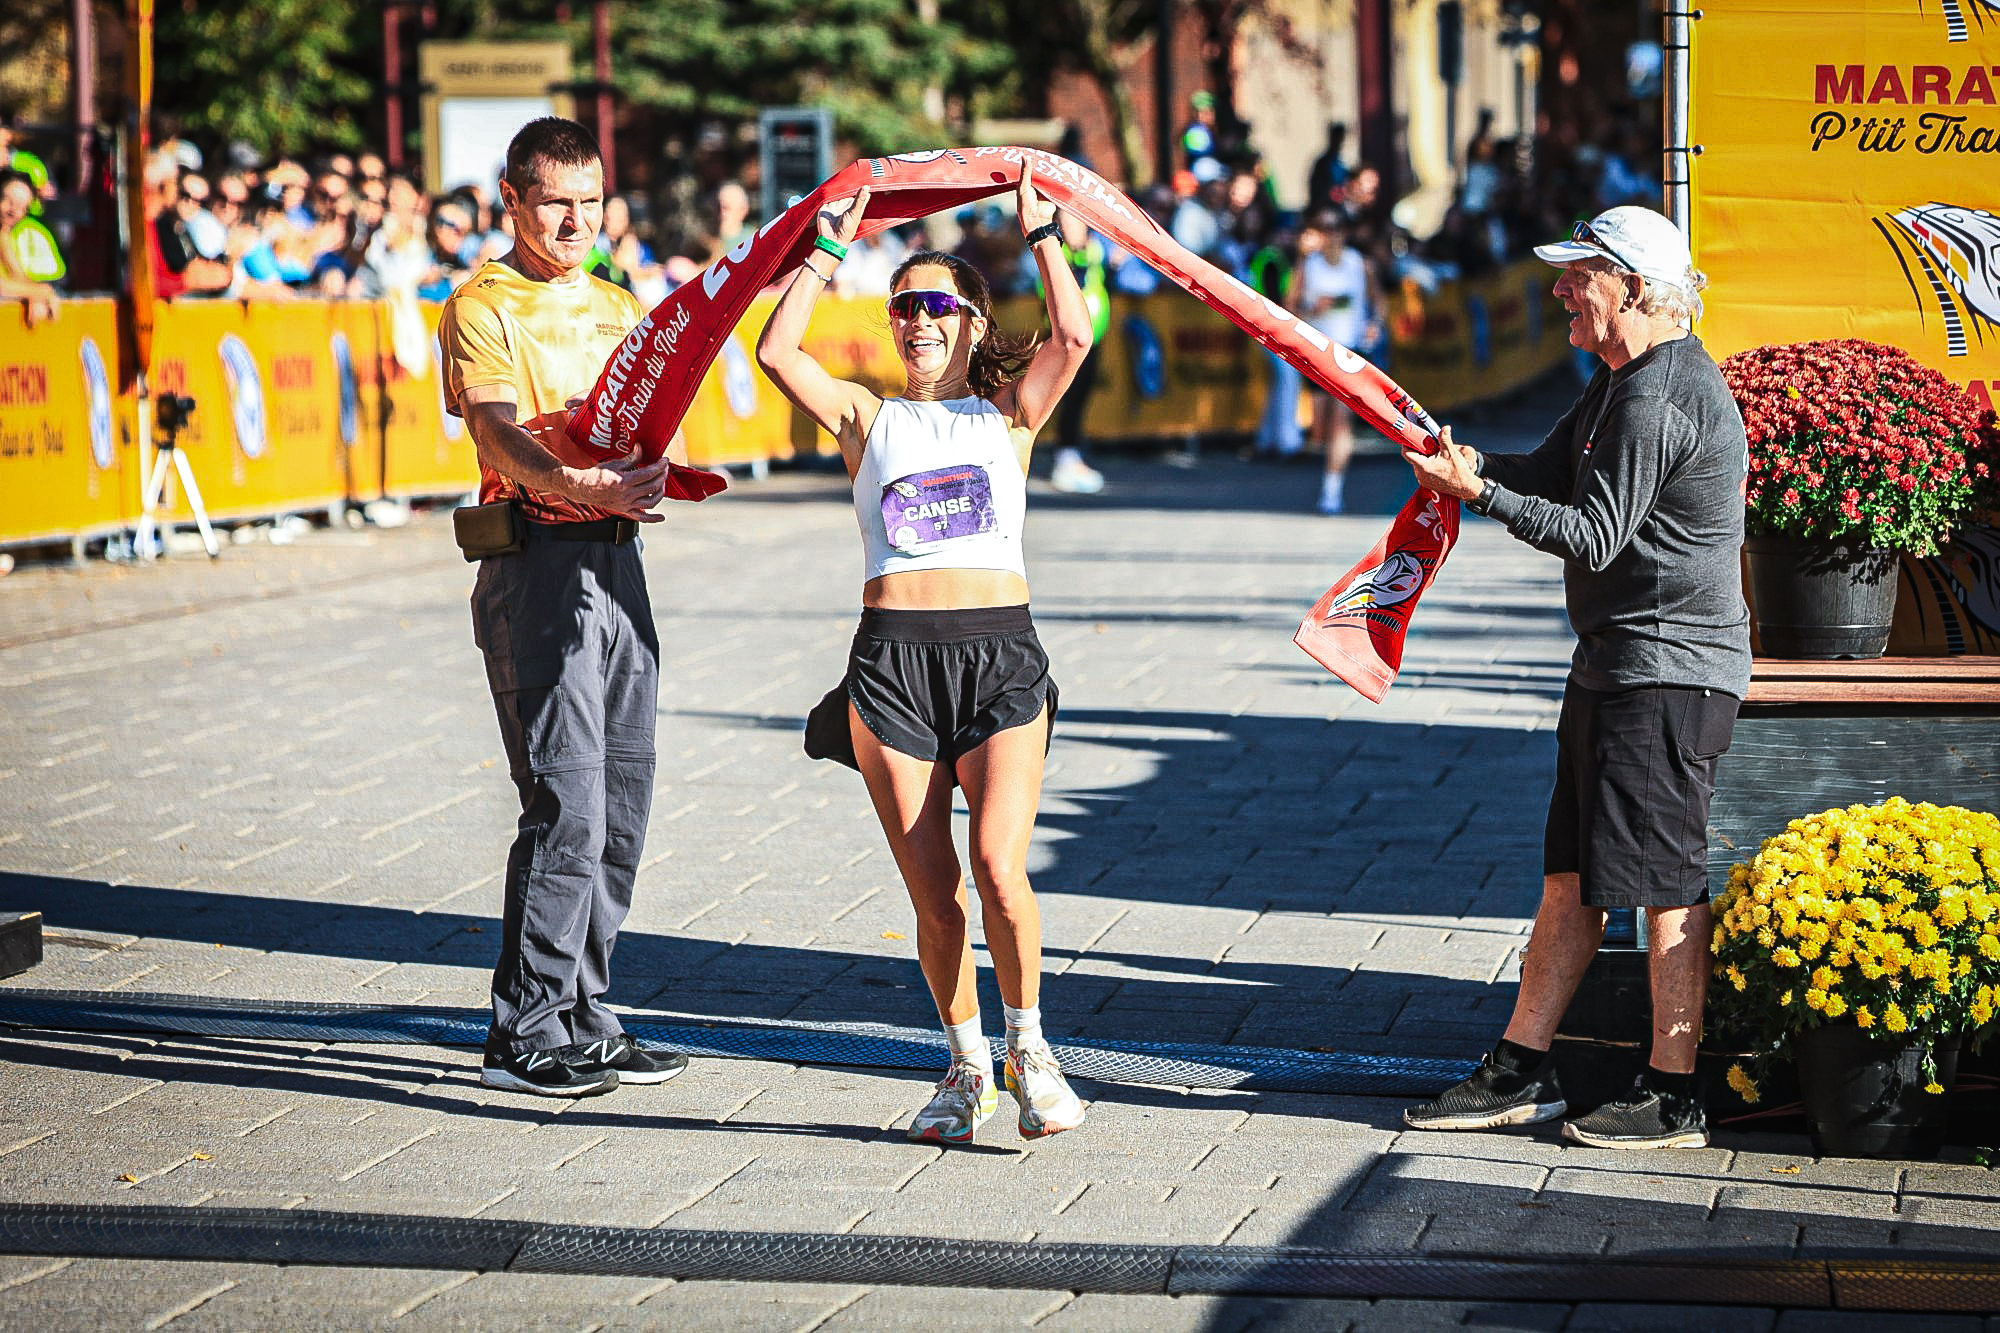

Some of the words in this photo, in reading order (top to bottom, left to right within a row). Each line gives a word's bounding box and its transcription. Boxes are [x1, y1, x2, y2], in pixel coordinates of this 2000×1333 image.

[1814, 65, 2000, 105] MARA
[1811, 112, 1906, 152] P'tit
[654, 302, 690, 356] Nord
[589, 314, 655, 448] MARATHON
[644, 354, 666, 379] du
[616, 377, 656, 431] Train
[904, 496, 973, 522] CANSE
